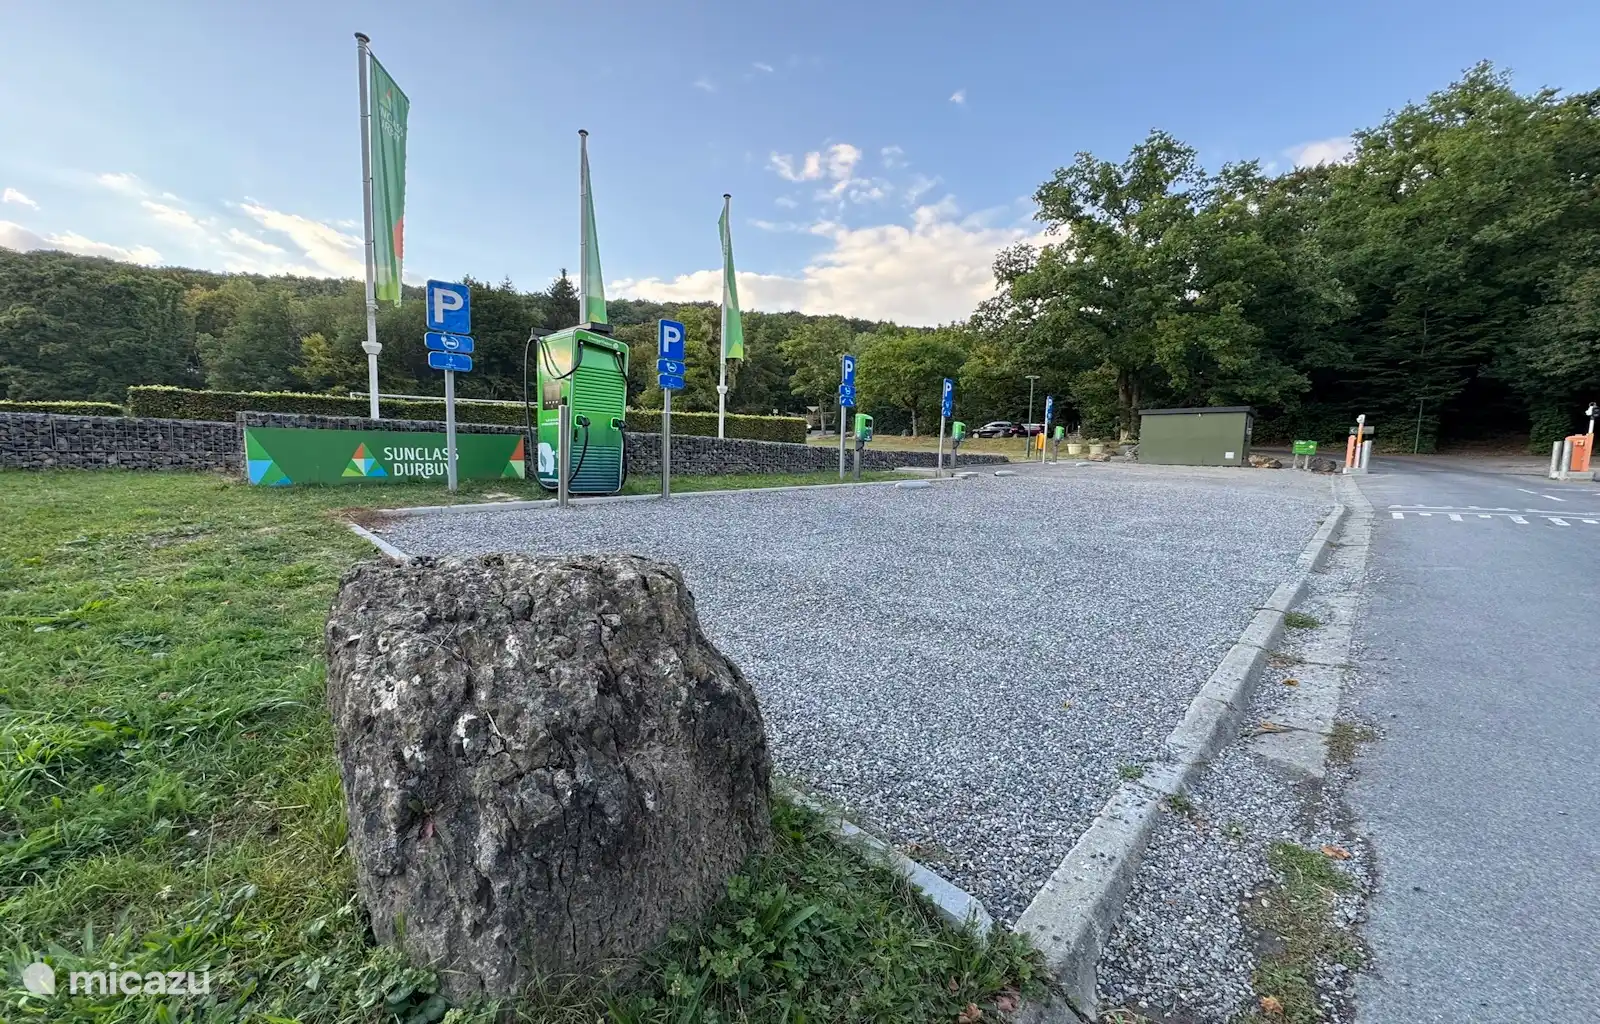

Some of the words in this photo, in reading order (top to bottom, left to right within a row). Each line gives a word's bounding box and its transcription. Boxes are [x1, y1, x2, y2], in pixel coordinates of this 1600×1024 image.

[433, 287, 464, 324] P
[663, 325, 681, 353] P
[844, 359, 853, 380] P
[945, 381, 952, 397] P
